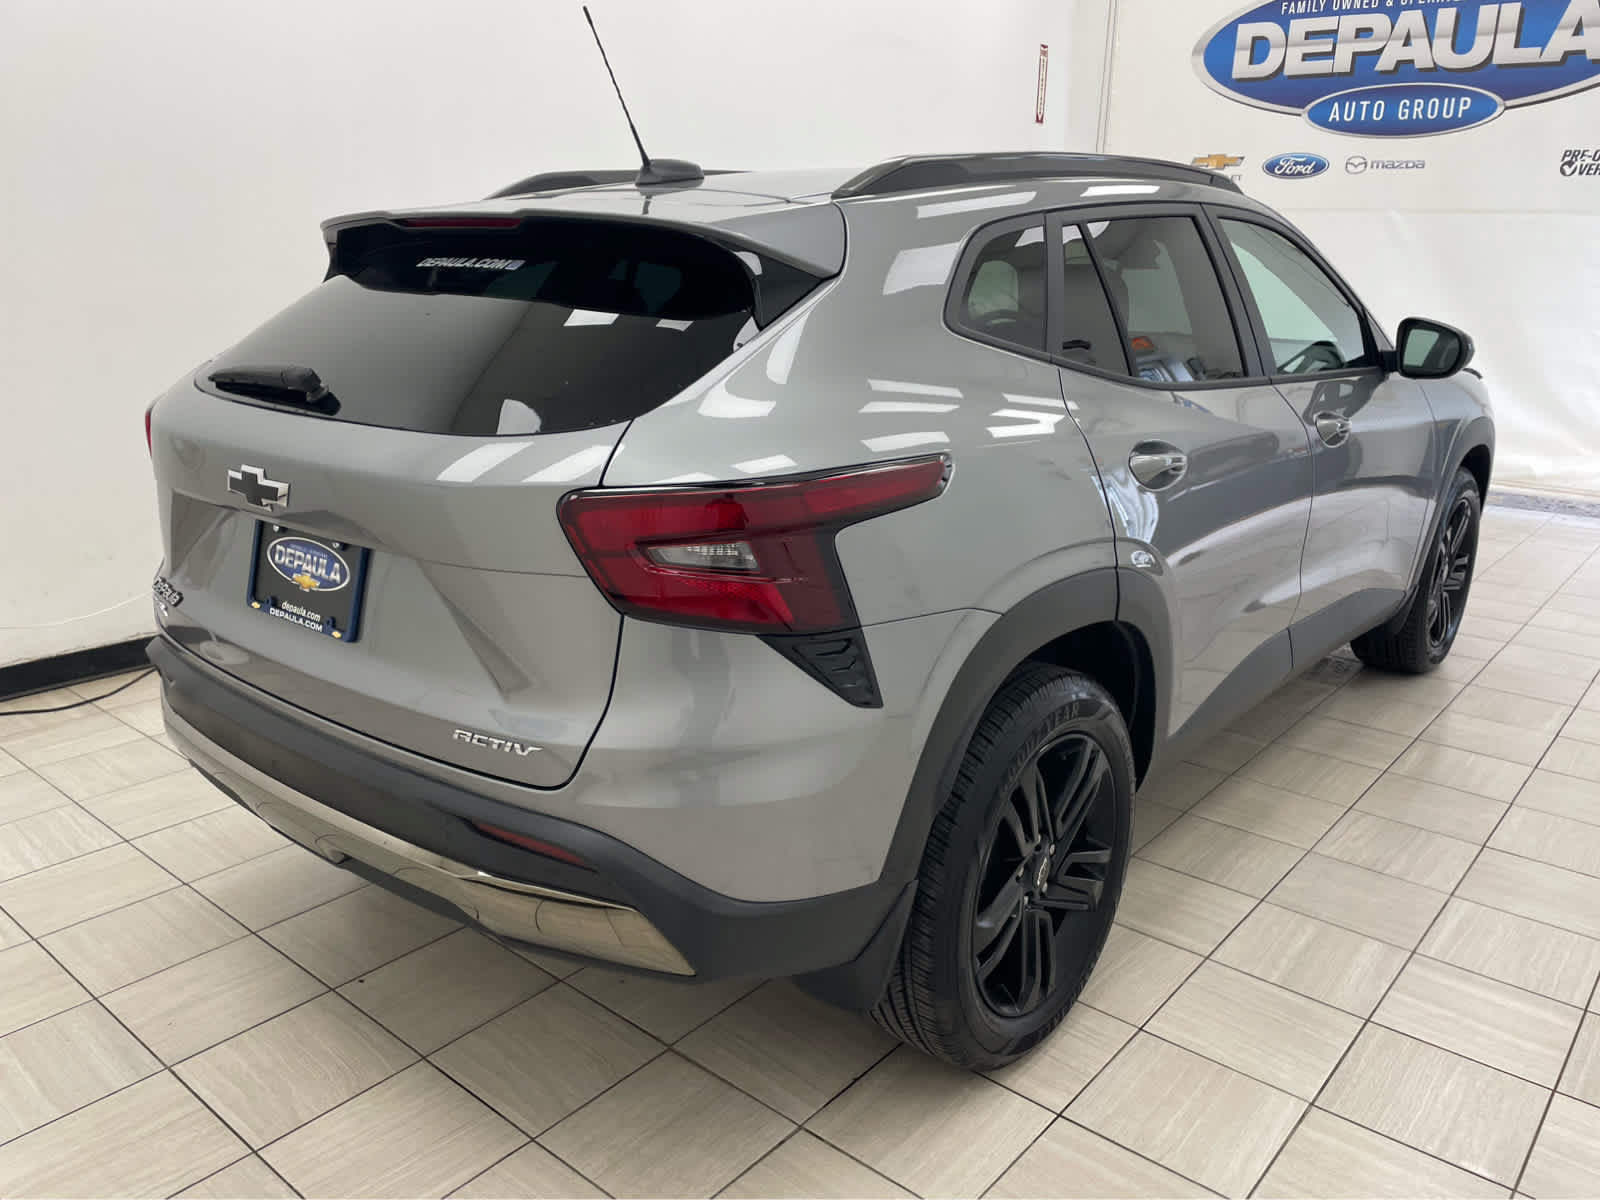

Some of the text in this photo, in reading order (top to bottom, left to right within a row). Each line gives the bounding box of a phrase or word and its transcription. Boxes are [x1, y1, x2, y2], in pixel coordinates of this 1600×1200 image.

[1281, 1, 1326, 15] FAMILY
[1333, 0, 1378, 12] OWNED
[1231, 0, 1600, 79] DEPAULA
[1328, 96, 1471, 122] AUTO GROUP
[1274, 156, 1315, 174] Ford
[1370, 159, 1426, 170] mazda
[275, 544, 340, 584] DEPAULA
[269, 607, 323, 632] DEPAULA.COM
[281, 601, 321, 622] depaula.com
[453, 729, 543, 756] ACTIV
